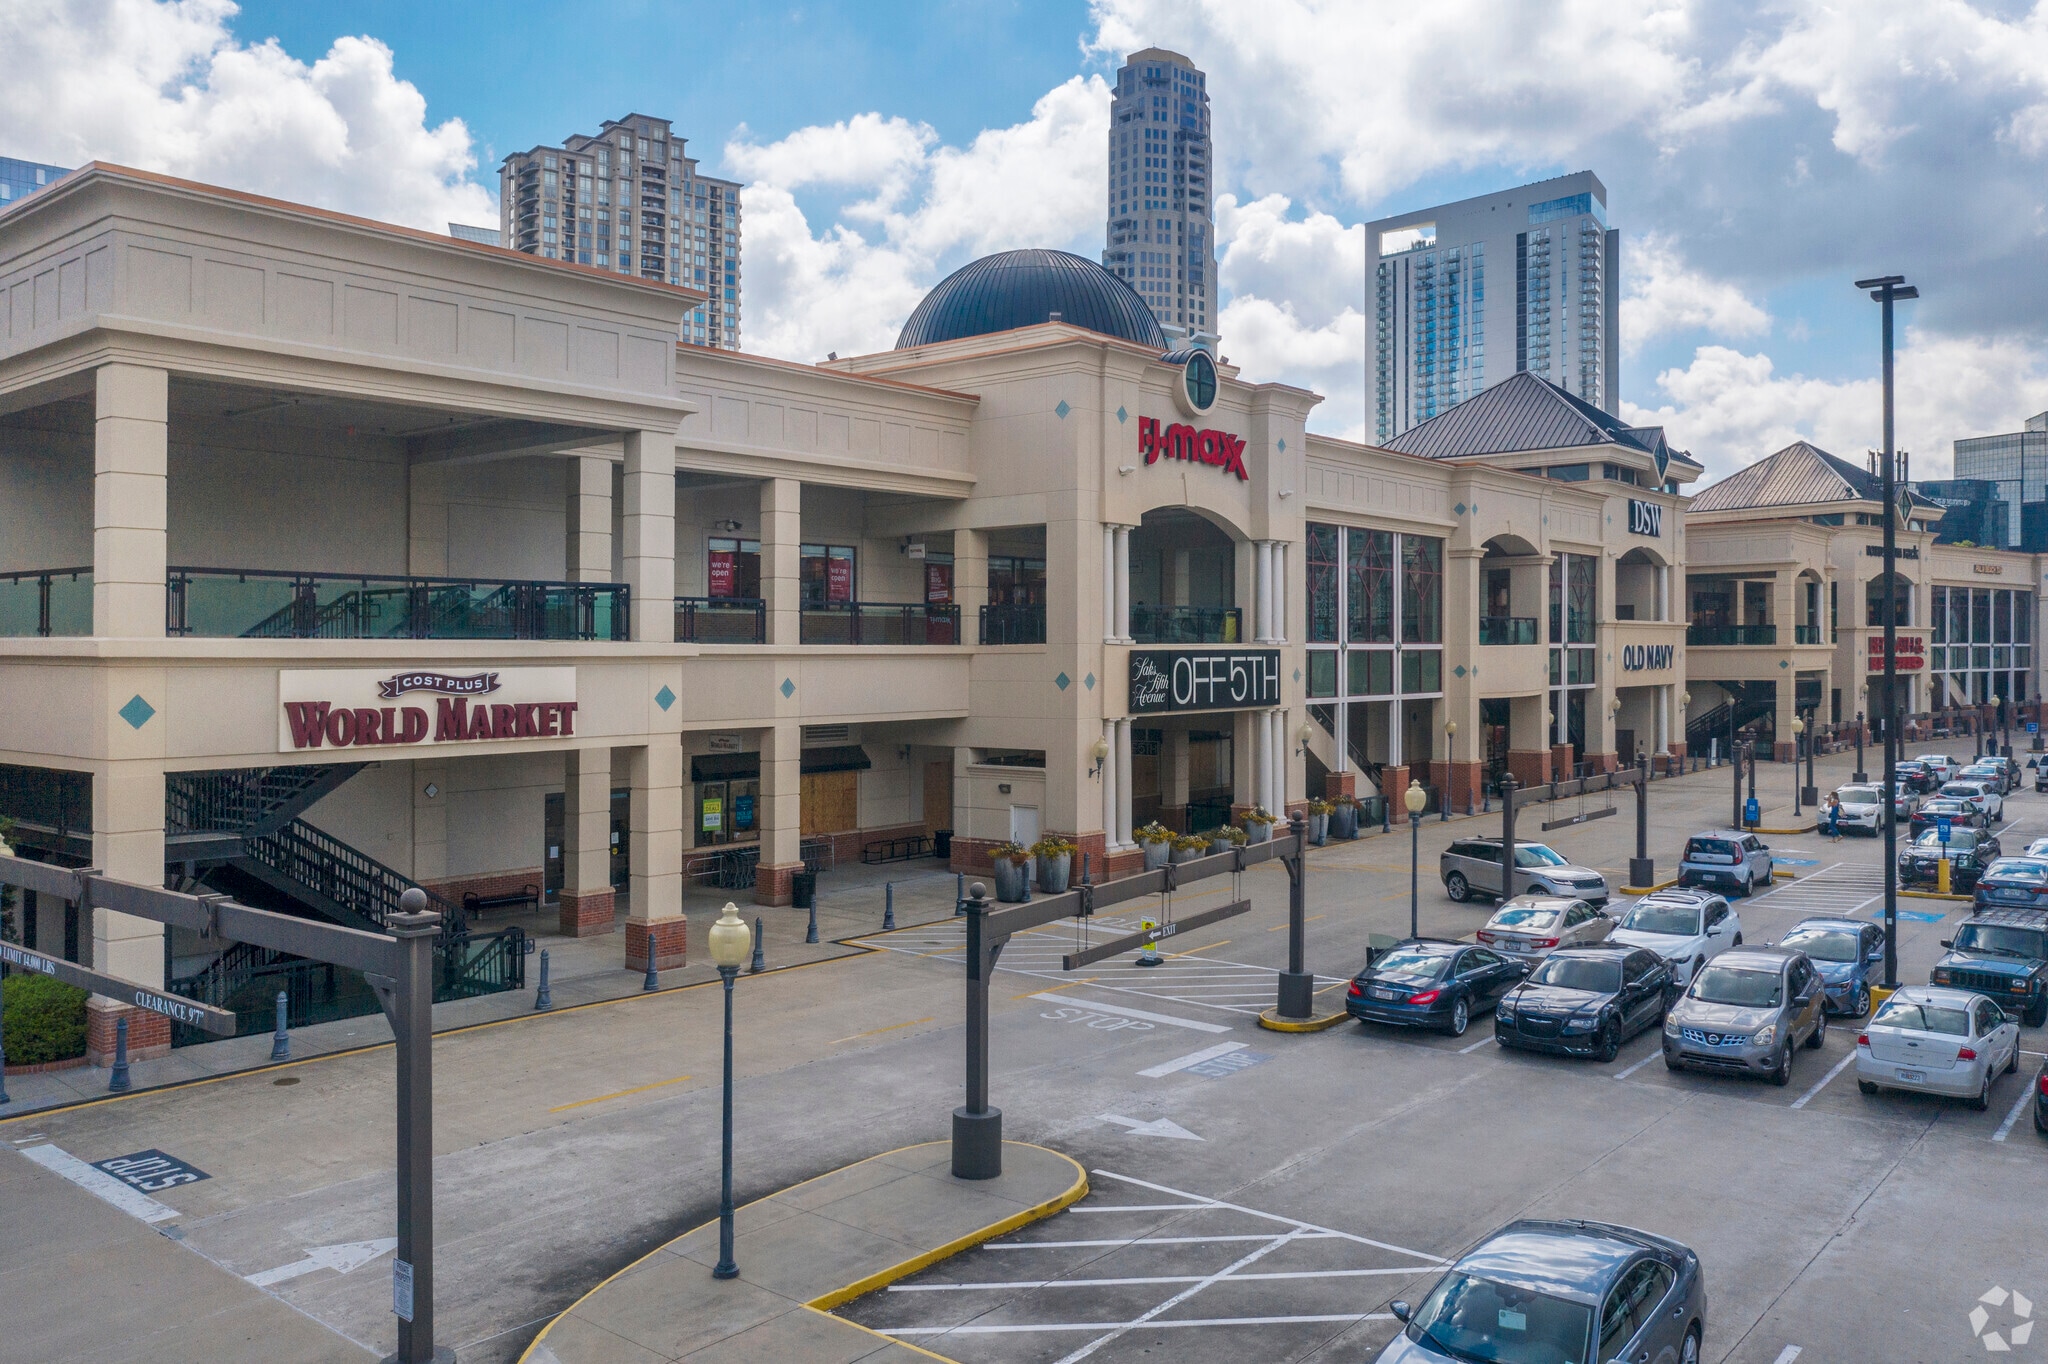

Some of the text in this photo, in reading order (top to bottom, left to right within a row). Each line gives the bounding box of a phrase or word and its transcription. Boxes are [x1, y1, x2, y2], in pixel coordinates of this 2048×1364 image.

[1633, 501, 1662, 537] DSW
[711, 569, 729, 577] open
[1131, 656, 1157, 681] Saks
[1623, 644, 1675, 671] OLD NAVY
[402, 676, 483, 690] COST PLUS
[1172, 655, 1279, 705] OFF 5TH
[1131, 683, 1167, 707] Avenue
[284, 697, 578, 748] WORLD MARKET
[1162, 923, 1177, 937] EXIT
[3, 946, 22, 964] LIMIT
[42, 958, 55, 975] LBS
[135, 991, 187, 1021] CLEARANCE
[1040, 1008, 1155, 1031] STOP
[1187, 1052, 1259, 1077] STOP
[101, 1156, 199, 1190] STOP
